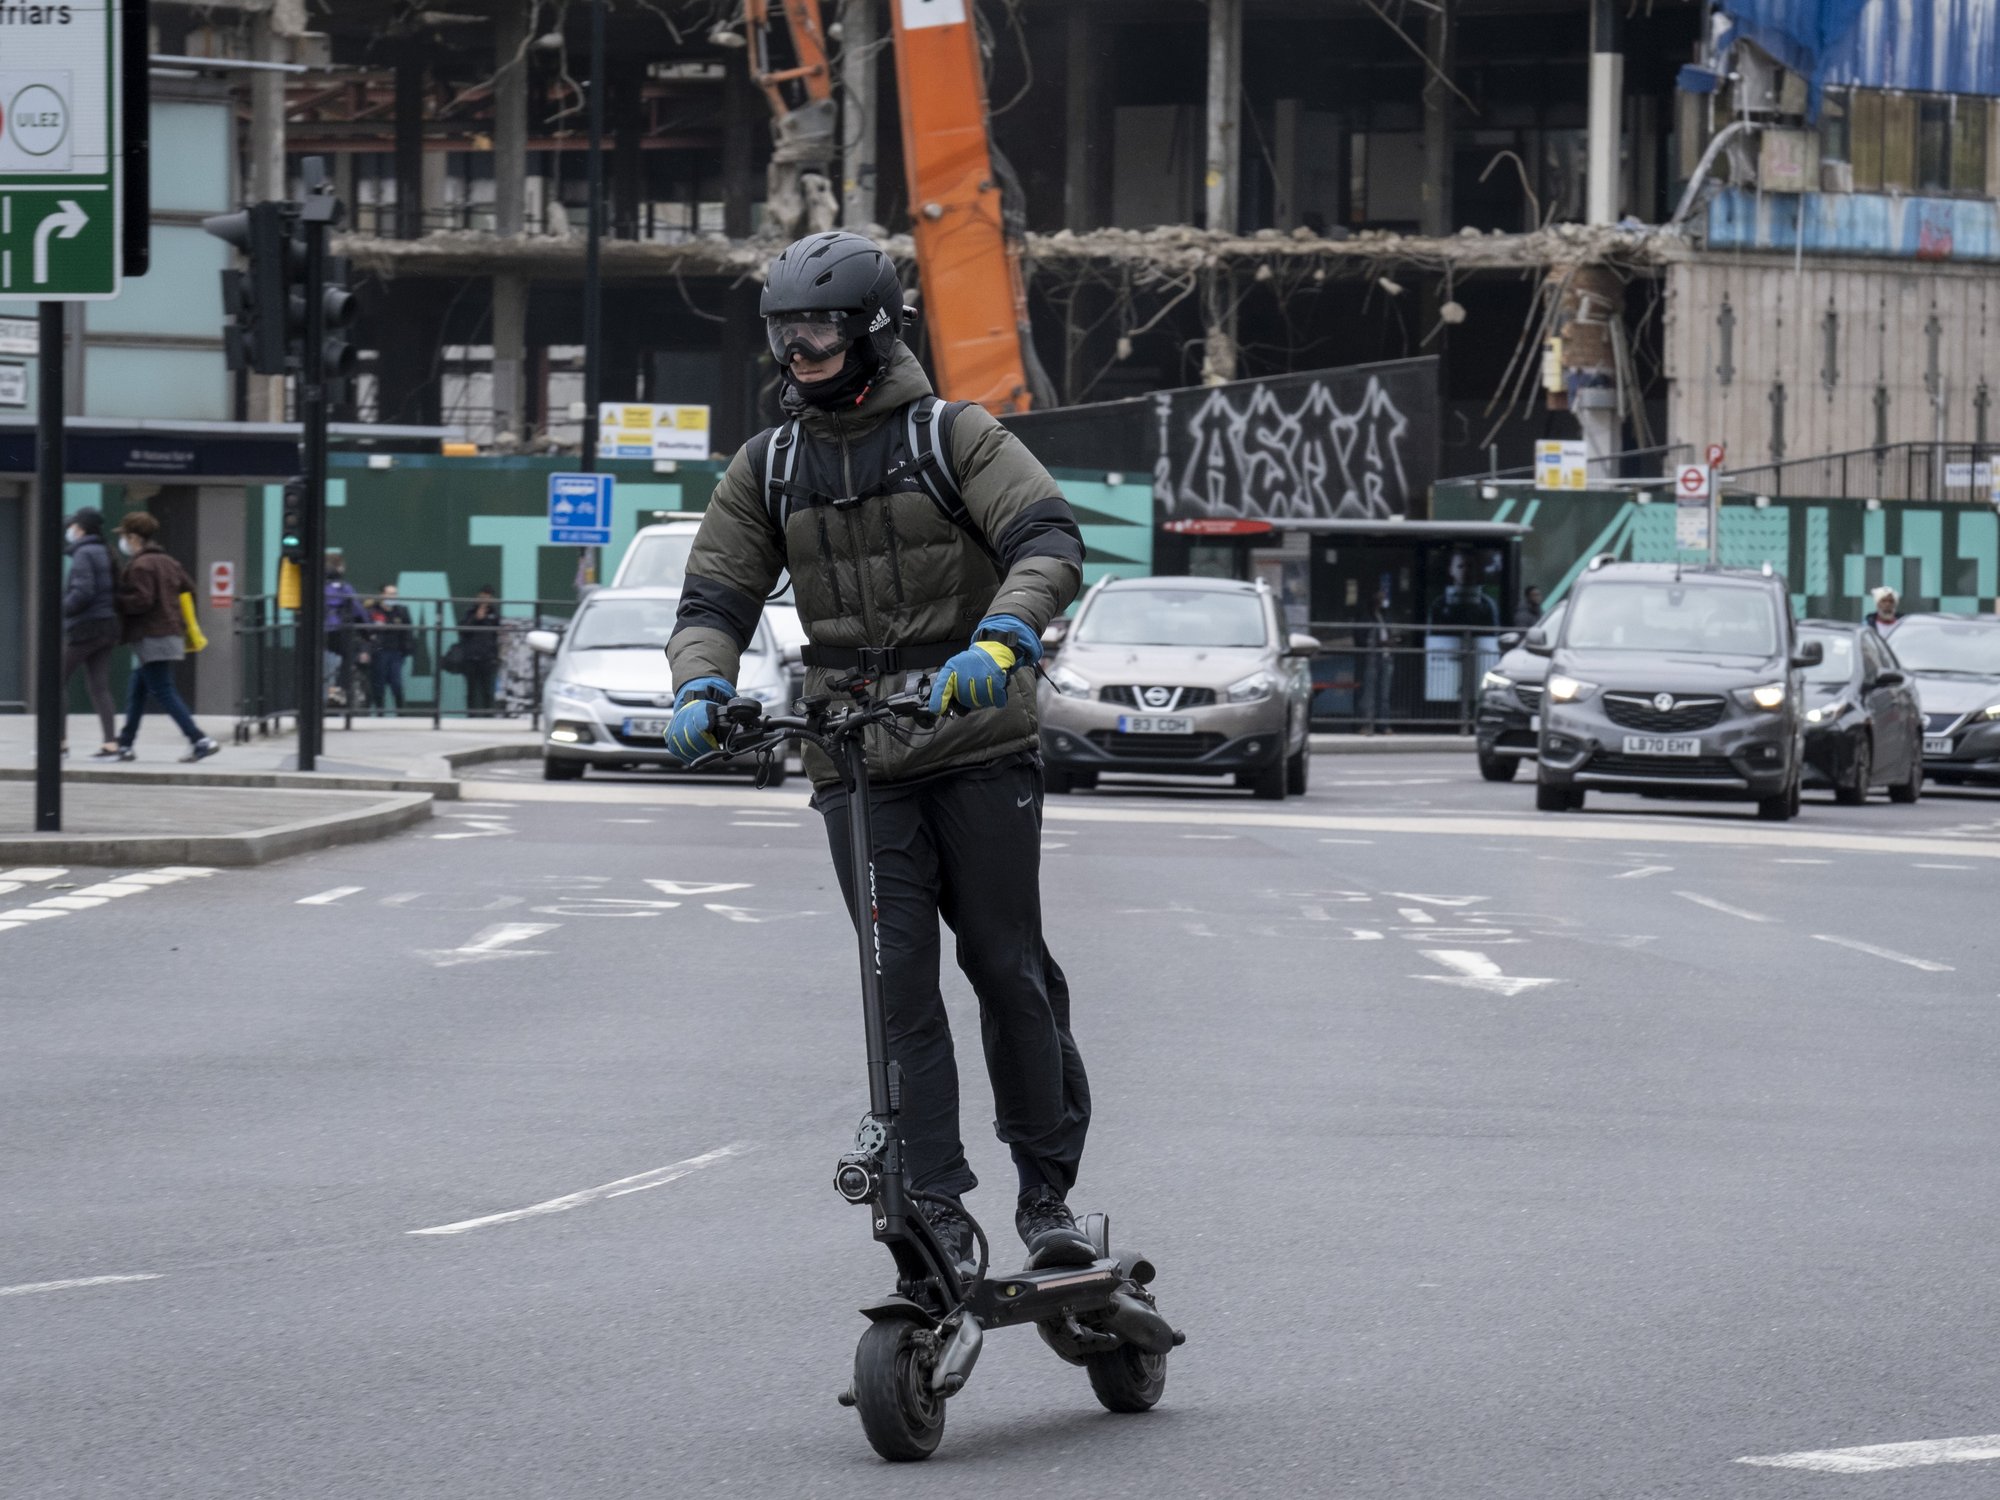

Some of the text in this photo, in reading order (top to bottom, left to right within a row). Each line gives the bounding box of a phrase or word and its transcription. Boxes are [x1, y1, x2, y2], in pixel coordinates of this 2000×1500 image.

[16, 112, 59, 127] ULEZ
[869, 316, 890, 332] adidas
[1667, 738, 1693, 753] EHY
